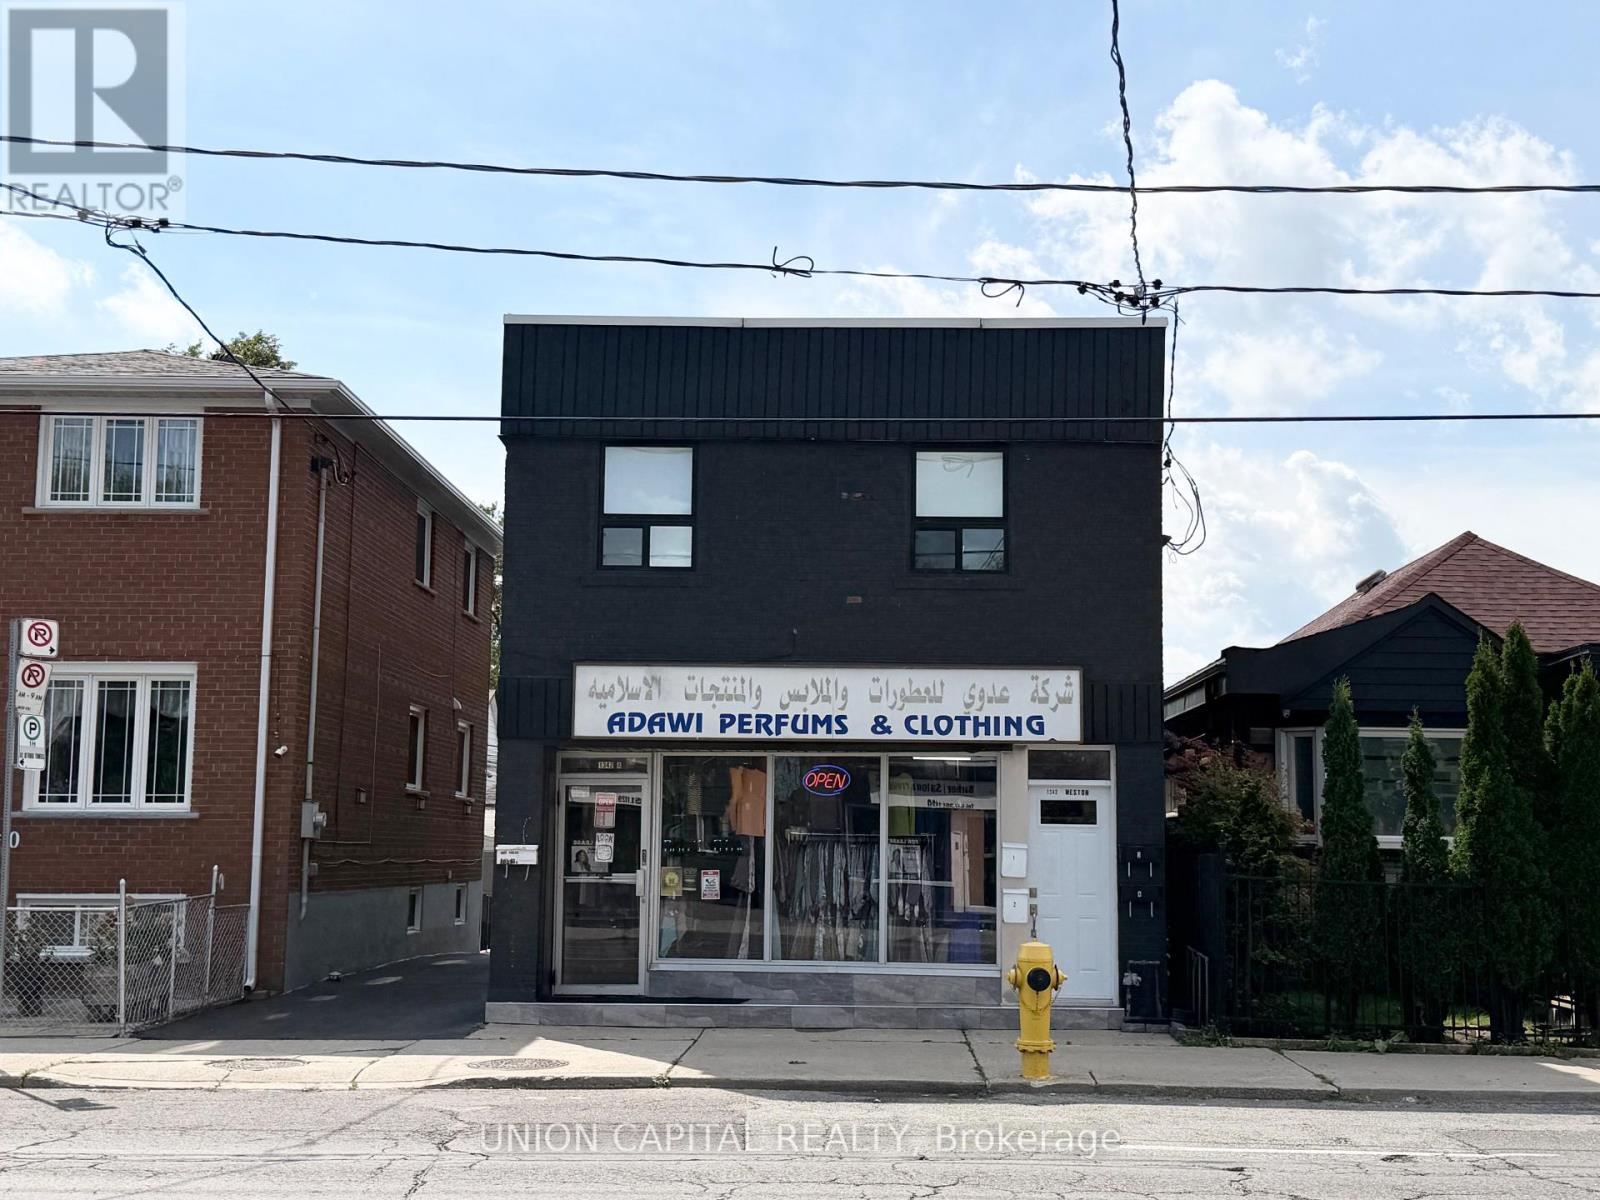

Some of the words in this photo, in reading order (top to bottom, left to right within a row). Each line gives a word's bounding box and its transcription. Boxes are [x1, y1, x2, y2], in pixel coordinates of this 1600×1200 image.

[684, 675, 762, 710] والمنتجات
[869, 676, 945, 711] للعطورات
[1030, 674, 1074, 713] شركة
[606, 711, 703, 735] ADAWI
[719, 712, 849, 737] PERFUMS
[870, 714, 893, 735] &
[904, 714, 1045, 738] CLOTHING
[805, 772, 847, 789] OPEN
[1065, 788, 1089, 796] WESTON
